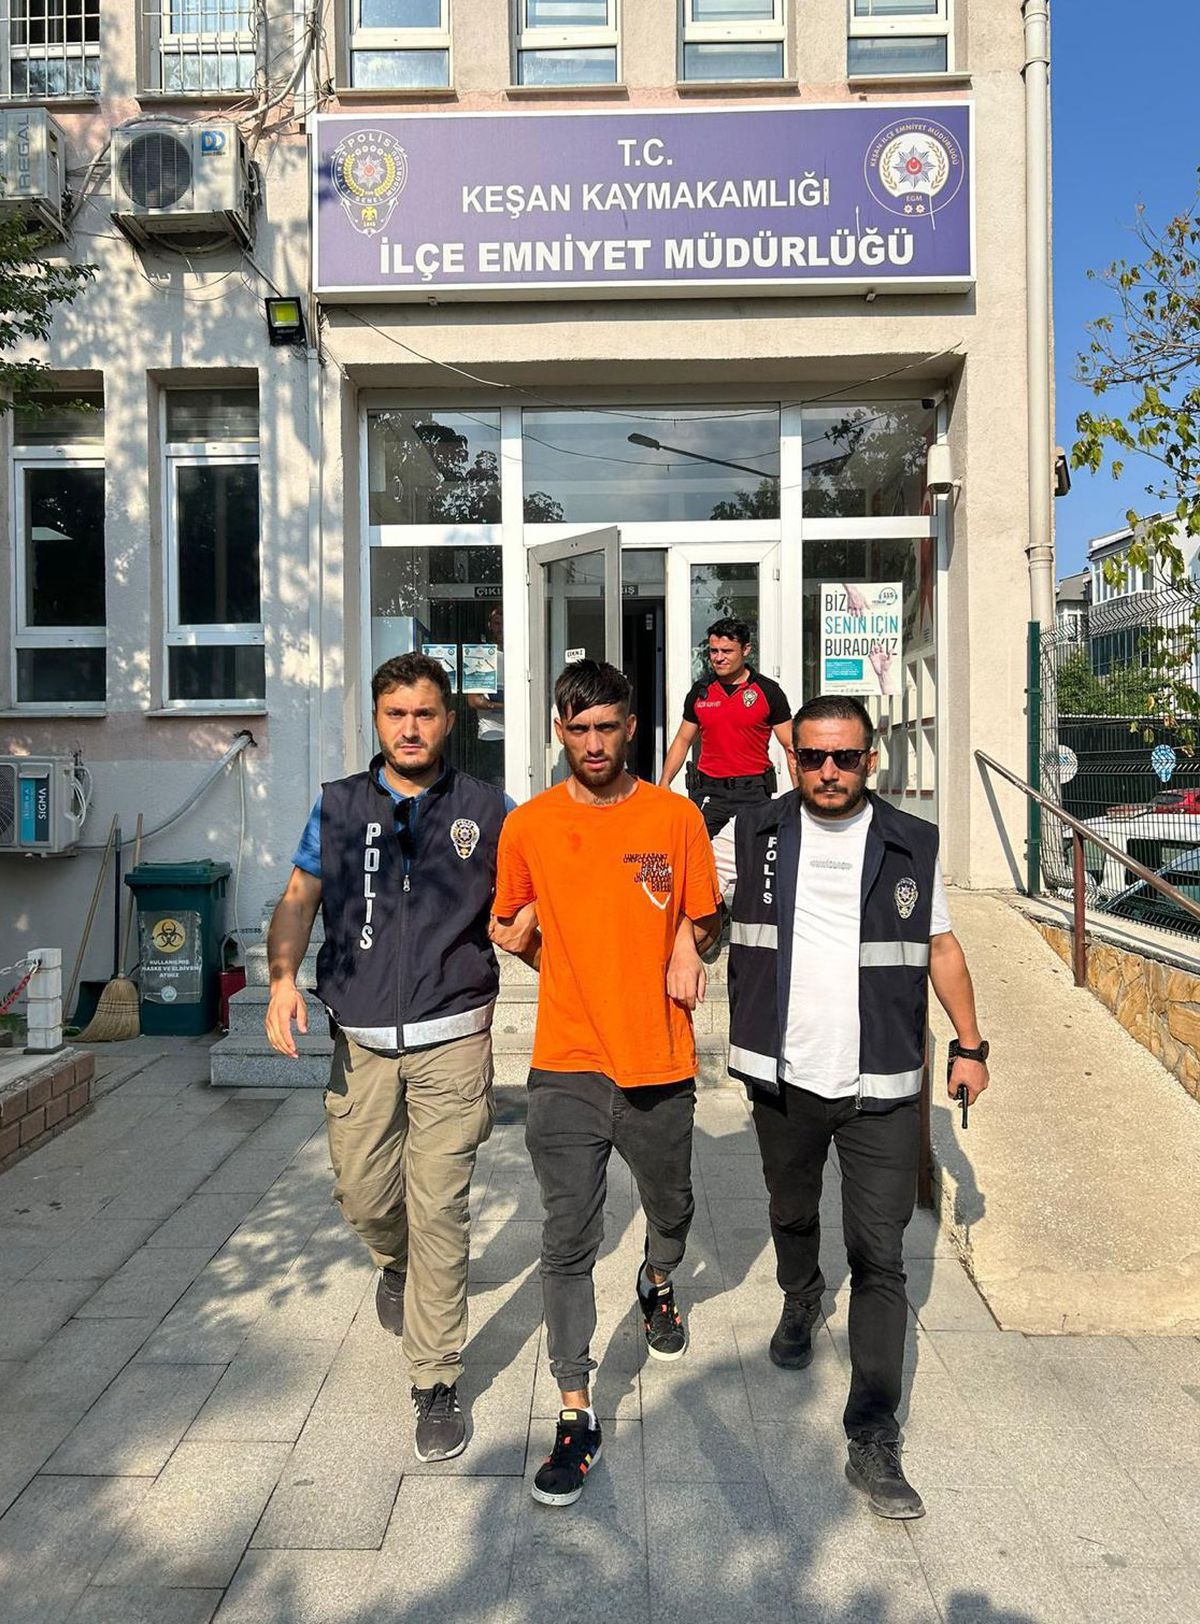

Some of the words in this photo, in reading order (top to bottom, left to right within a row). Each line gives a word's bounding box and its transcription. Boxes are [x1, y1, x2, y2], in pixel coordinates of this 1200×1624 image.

[18, 112, 31, 189] REGAL
[618, 138, 673, 166] T.C.
[462, 184, 571, 219] KEŞAN
[582, 171, 830, 212] KAYMAKAMLIĞI
[380, 236, 465, 281] İLÇE
[478, 233, 652, 273] EMNİYET
[664, 227, 915, 270] MÜDÜRLÜĞÜ
[825, 590, 847, 612] BİZ
[871, 611, 899, 636] İÇİN
[38, 787, 47, 820] SIGMA
